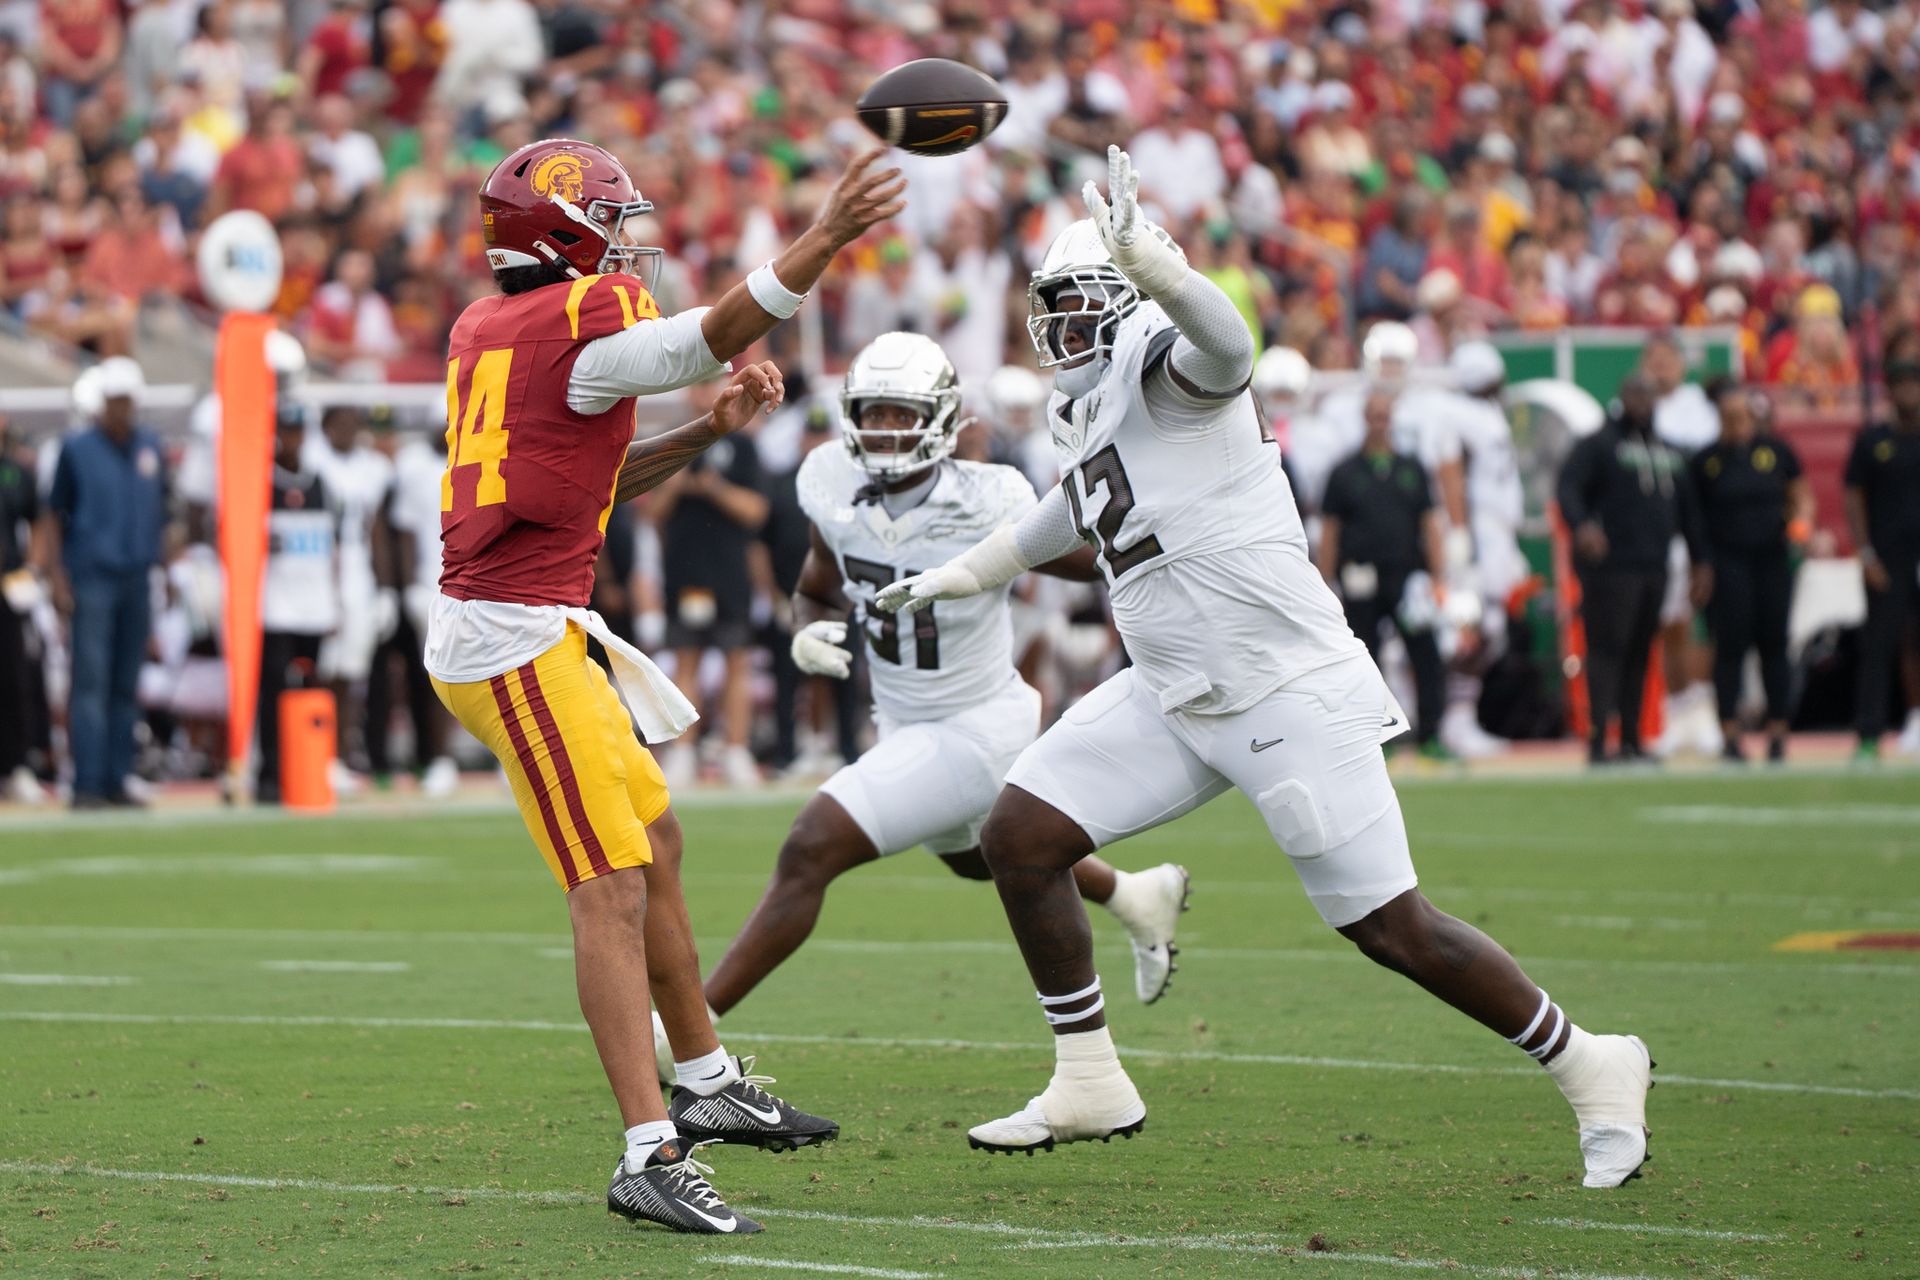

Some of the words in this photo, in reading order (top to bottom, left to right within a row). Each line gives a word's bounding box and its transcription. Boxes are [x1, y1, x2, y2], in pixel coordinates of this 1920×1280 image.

[490, 253, 508, 266] ON!
[611, 285, 660, 329] 14
[440, 348, 514, 512] 14
